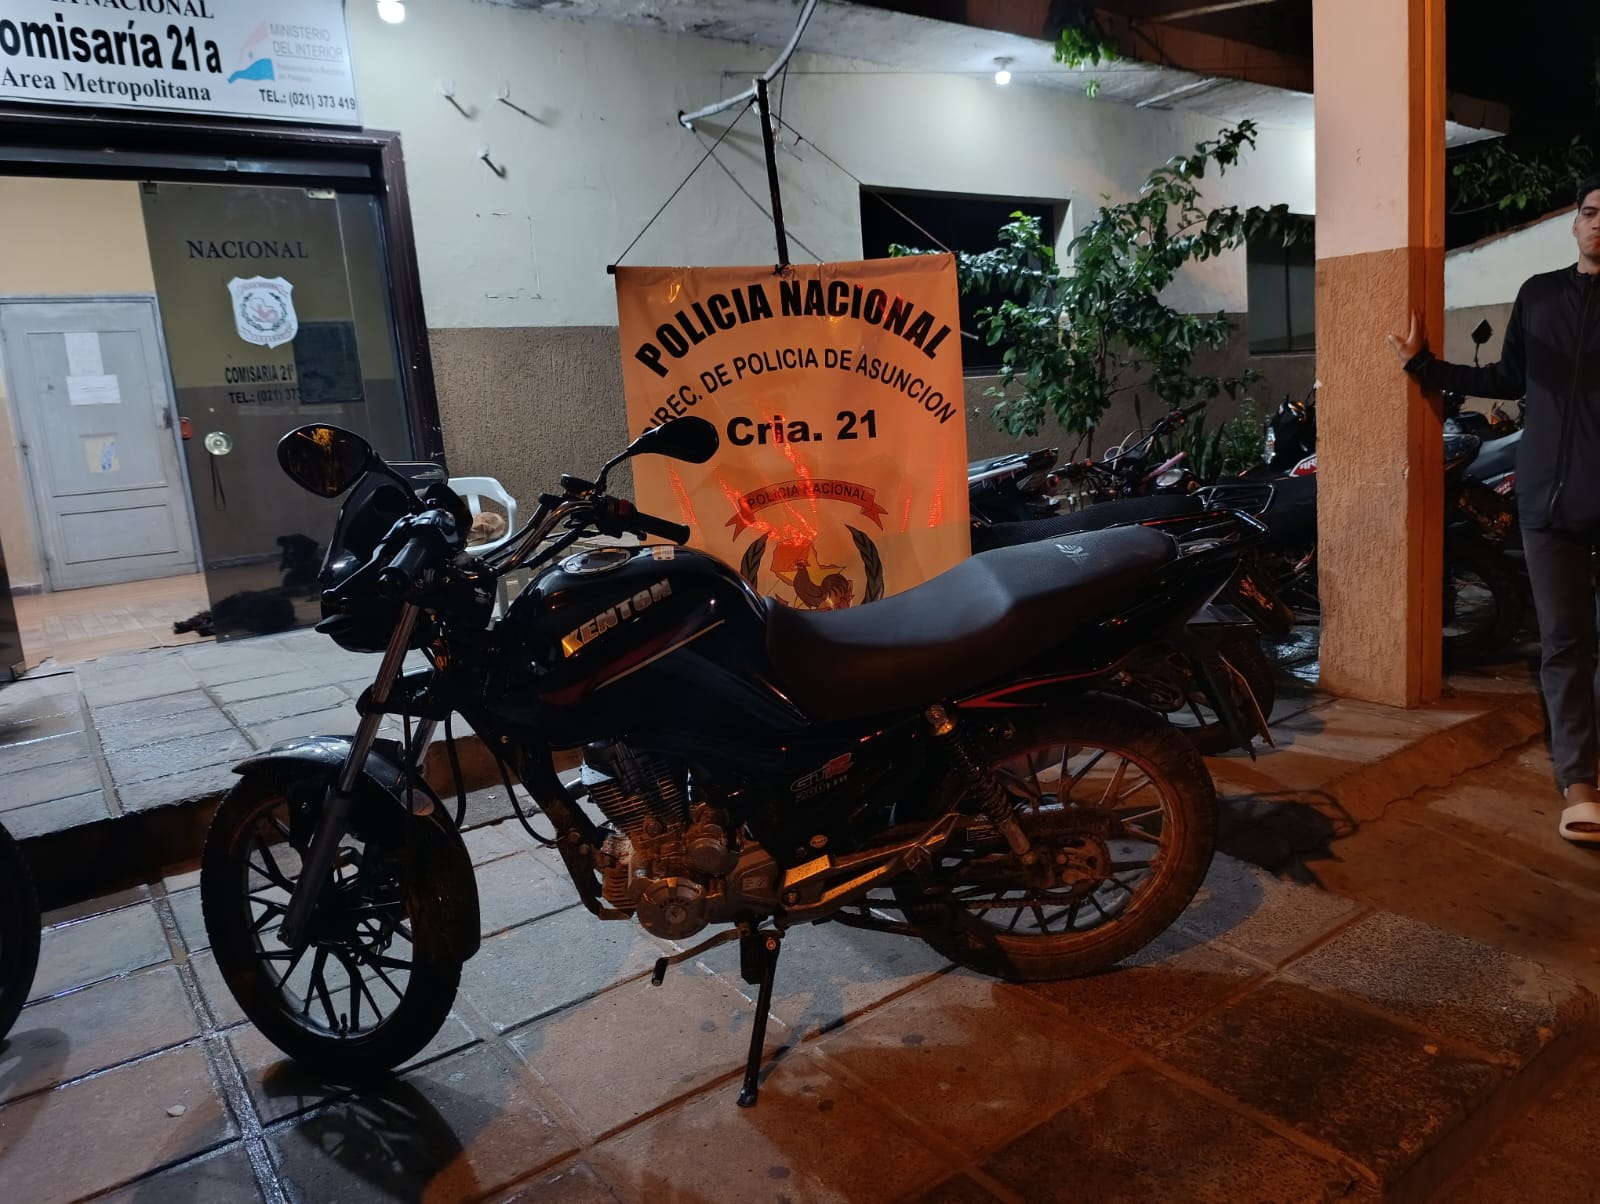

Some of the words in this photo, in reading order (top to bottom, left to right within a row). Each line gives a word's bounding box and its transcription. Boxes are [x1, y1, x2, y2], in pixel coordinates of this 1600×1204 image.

[0, 12, 163, 69] omisaría
[270, 23, 330, 41] MINISTERIO
[272, 40, 294, 55] DEL
[296, 43, 345, 60] INTERIOR
[1, 67, 56, 90] Area
[62, 71, 212, 101] Metropolitana
[258, 88, 287, 104] TEL.:
[289, 91, 316, 110] (021)
[317, 94, 336, 109] 373
[338, 96, 357, 111] 419
[186, 239, 309, 259] NACIONAL
[634, 282, 773, 378] POLICIA
[781, 280, 952, 360] NACIONAL
[225, 365, 278, 384] COMISARIA
[642, 384, 703, 434] IREC.
[700, 363, 733, 394] DE
[733, 347, 819, 381] POLICIA
[824, 349, 853, 371] DE
[856, 353, 957, 425] ASUNCION
[726, 414, 823, 446] Cria.
[836, 409, 878, 441] 21
[747, 484, 799, 507] POLICIA
[803, 481, 868, 502] NACIONAL
[560, 577, 673, 658] KENTON
